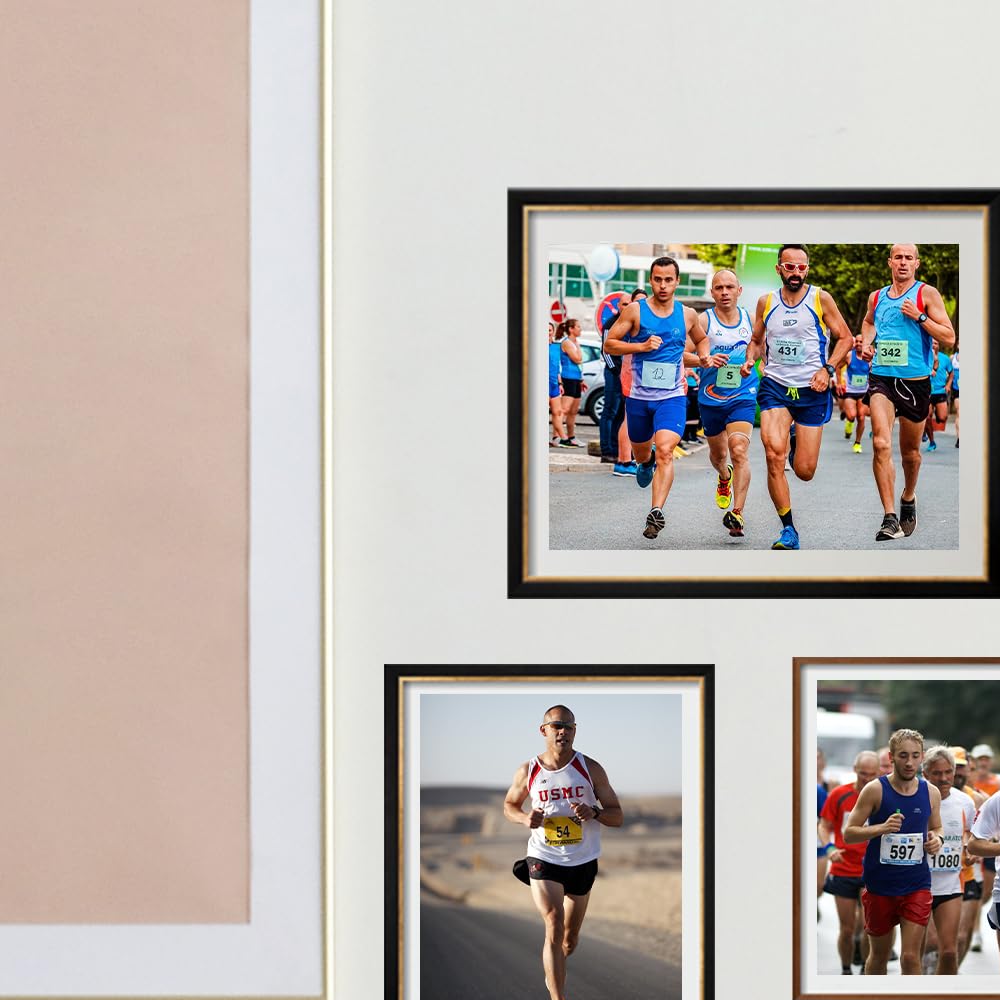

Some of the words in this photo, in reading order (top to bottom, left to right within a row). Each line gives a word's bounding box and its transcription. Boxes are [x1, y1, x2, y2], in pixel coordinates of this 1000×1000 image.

[778, 346, 797, 356] 431
[881, 348, 901, 357] 342
[726, 371, 734, 380] 5
[538, 786, 585, 802] USMC
[556, 825, 570, 838] 54
[890, 845, 915, 860] 597
[931, 854, 960, 868] 1080
